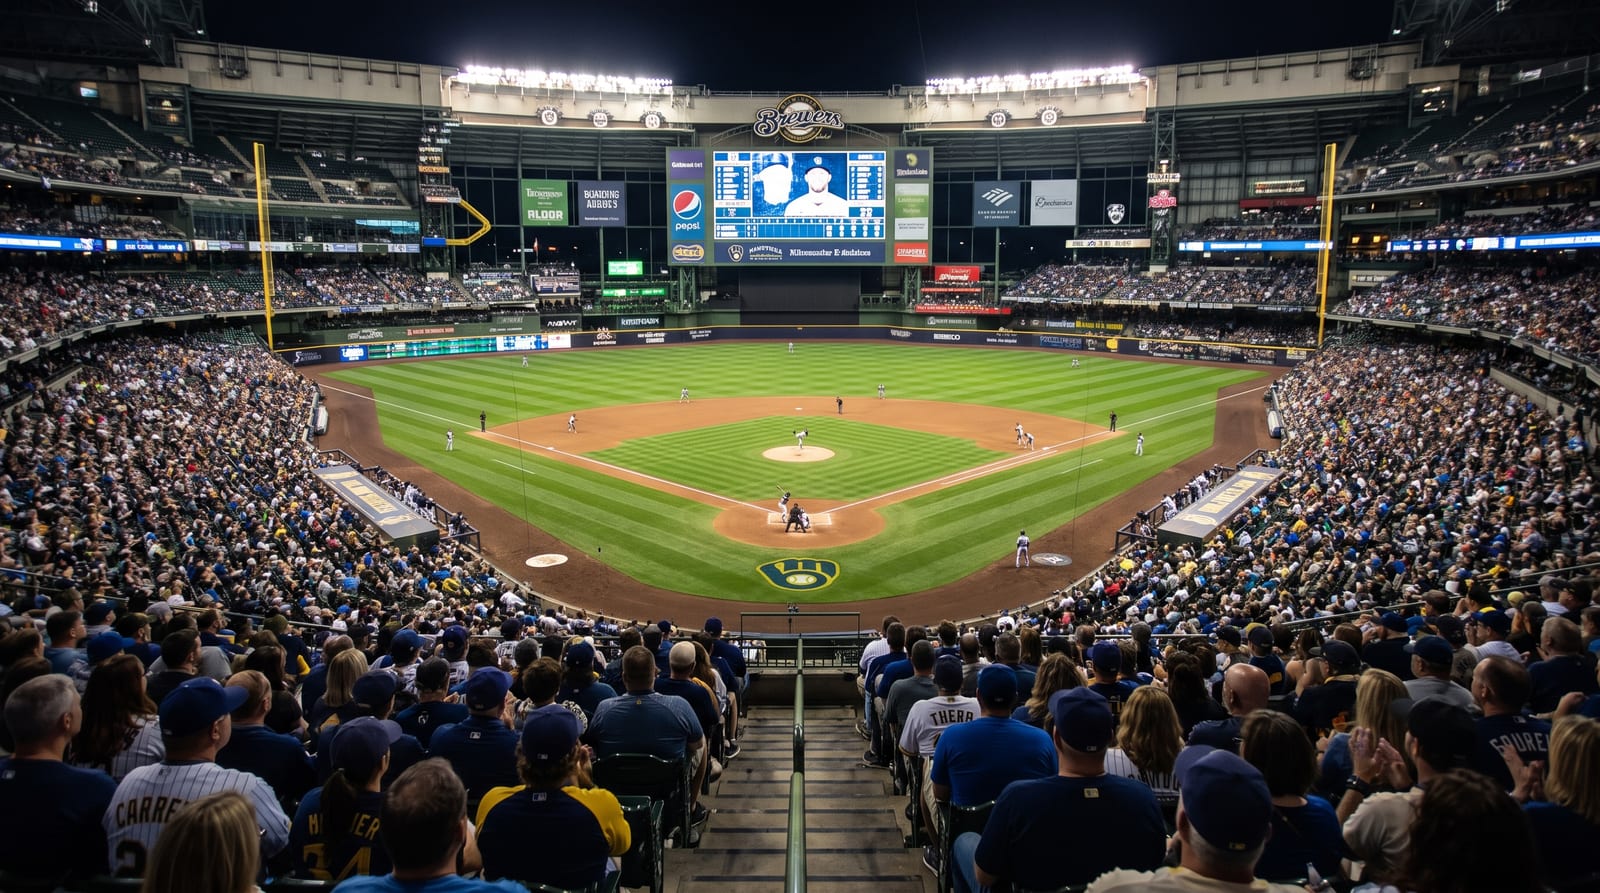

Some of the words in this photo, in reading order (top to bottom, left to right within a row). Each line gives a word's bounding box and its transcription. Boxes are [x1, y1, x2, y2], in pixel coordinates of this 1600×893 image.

[754, 107, 845, 138] Brewers
[675, 222, 701, 231] pepsi
[116, 796, 189, 828] CARRE
